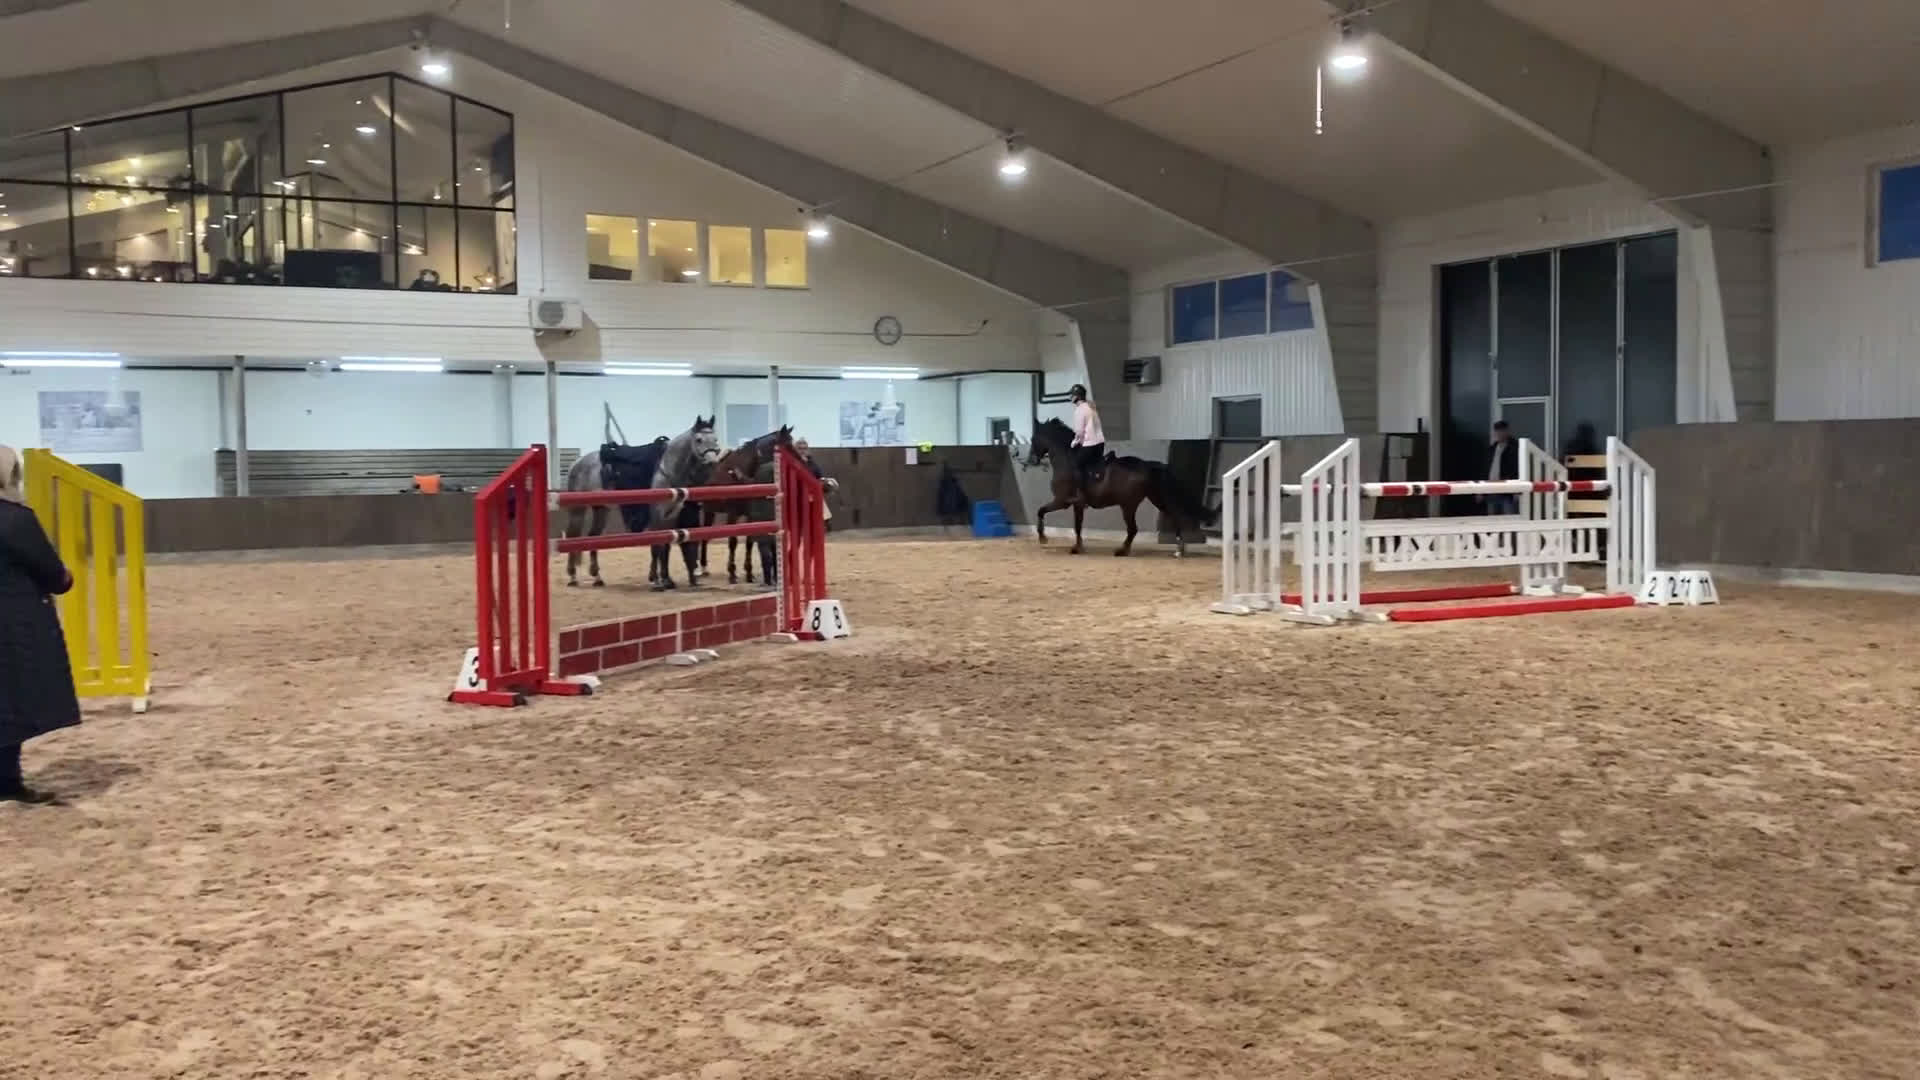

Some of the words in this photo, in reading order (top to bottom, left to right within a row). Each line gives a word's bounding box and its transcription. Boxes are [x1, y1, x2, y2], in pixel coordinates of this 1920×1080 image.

[1648, 576, 1657, 597] 2
[1668, 576, 1678, 597] 2
[812, 607, 821, 631] 8
[469, 656, 479, 687] 3
